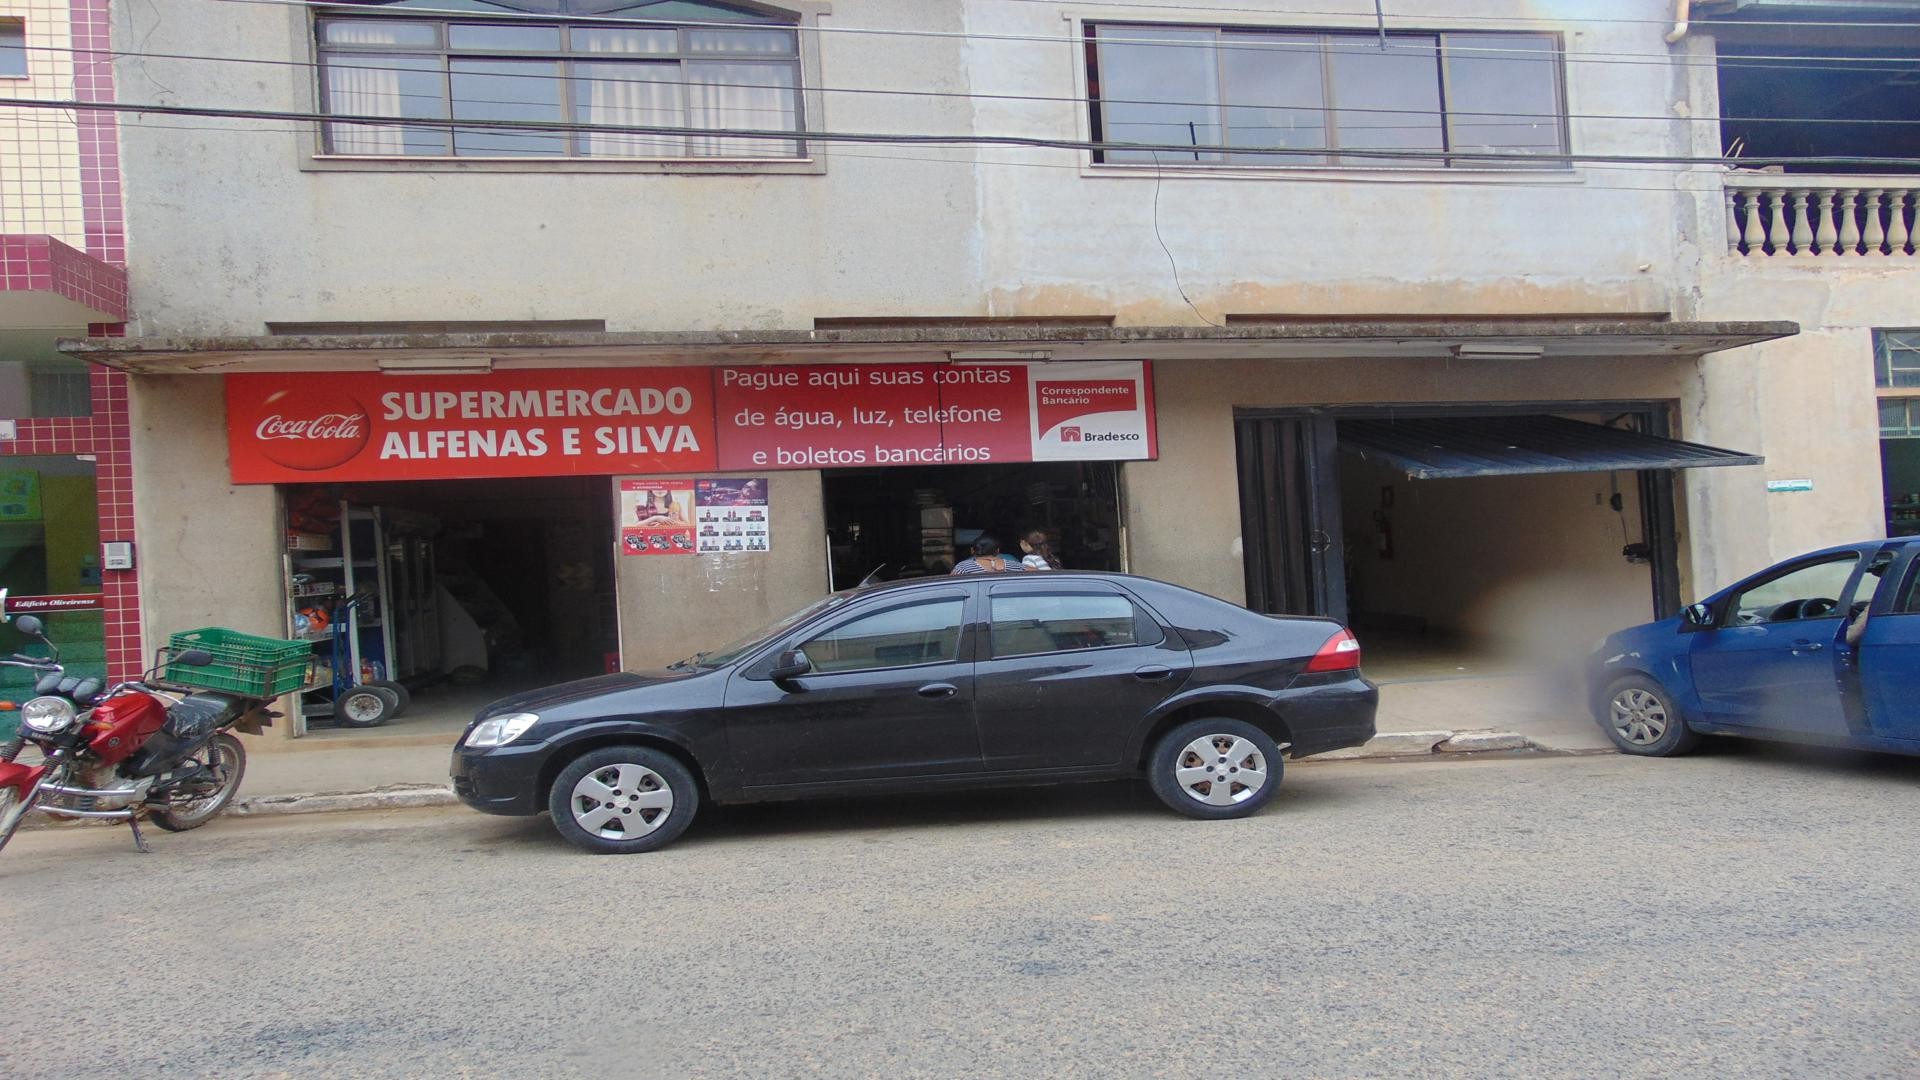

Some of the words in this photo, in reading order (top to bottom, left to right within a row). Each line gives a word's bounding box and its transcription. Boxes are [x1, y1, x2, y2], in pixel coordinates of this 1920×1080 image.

[722, 369, 799, 390] Pague
[808, 369, 859, 389] aqui
[869, 369, 924, 386] suas
[932, 367, 1011, 385] contas
[382, 387, 692, 420] SUPERMERCADO
[1041, 386, 1129, 398] Correspondente
[1042, 396, 1090, 405] Bancário
[256, 413, 365, 440] Coca-Cola
[734, 408, 765, 426] de
[774, 405, 843, 430] água,
[852, 406, 894, 427] luz,
[904, 405, 1002, 424] telefone
[380, 428, 548, 460] ALFENAS
[562, 428, 581, 455] E
[595, 425, 700, 455] SILVA
[1084, 431, 1140, 443] Bradesco
[752, 450, 768, 465] e
[776, 446, 866, 464] boletos
[875, 443, 991, 463] bancários
